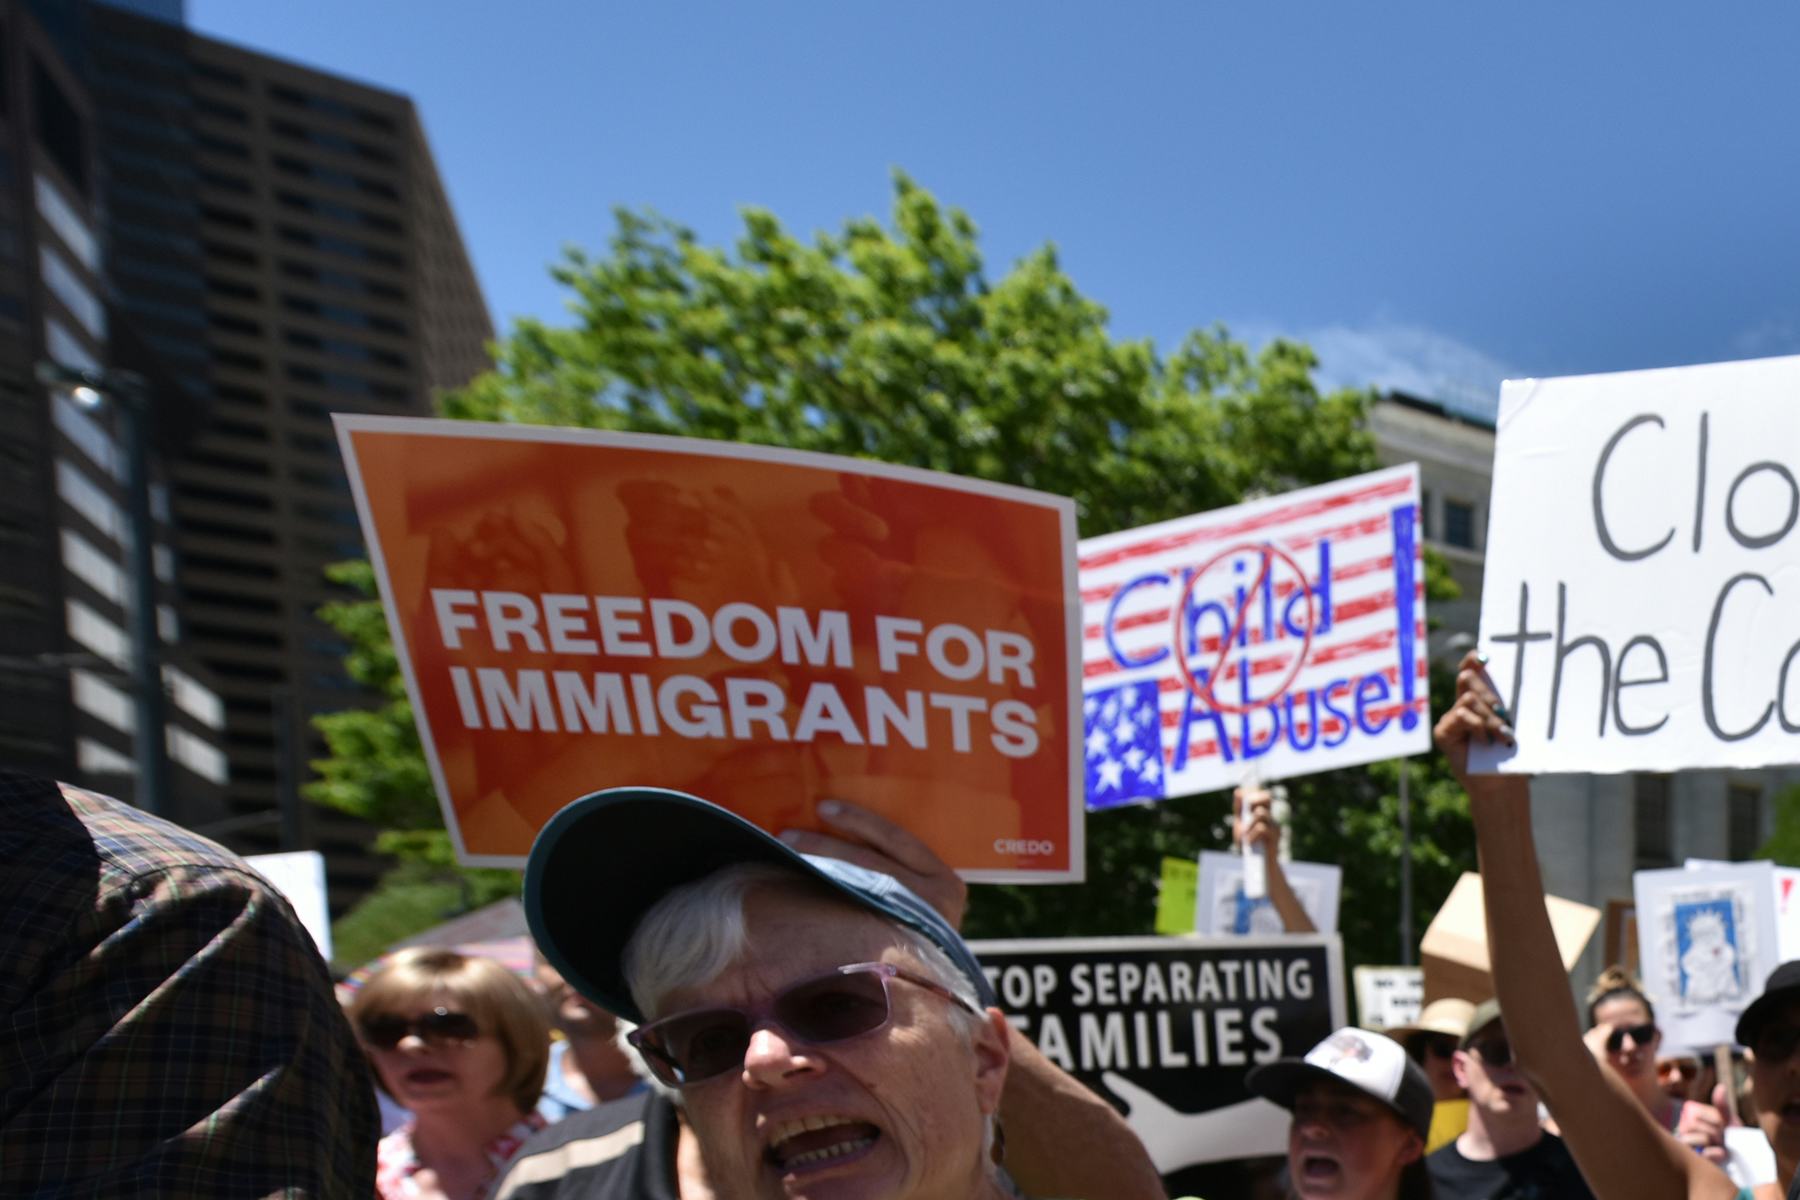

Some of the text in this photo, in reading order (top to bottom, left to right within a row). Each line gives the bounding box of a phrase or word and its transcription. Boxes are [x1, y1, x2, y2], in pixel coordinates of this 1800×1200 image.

[430, 587, 1035, 688] FREEDOM FOR
[1105, 538, 1331, 668] Child
[1172, 505, 1420, 772] Abuse!
[1490, 581, 1669, 739] the
[449, 665, 1039, 758] IMMIGRANTS
[993, 838, 1055, 856] CREDO
[1070, 959, 1313, 1006] SEPARATING
[1005, 1008, 1283, 1071] AMILIES
